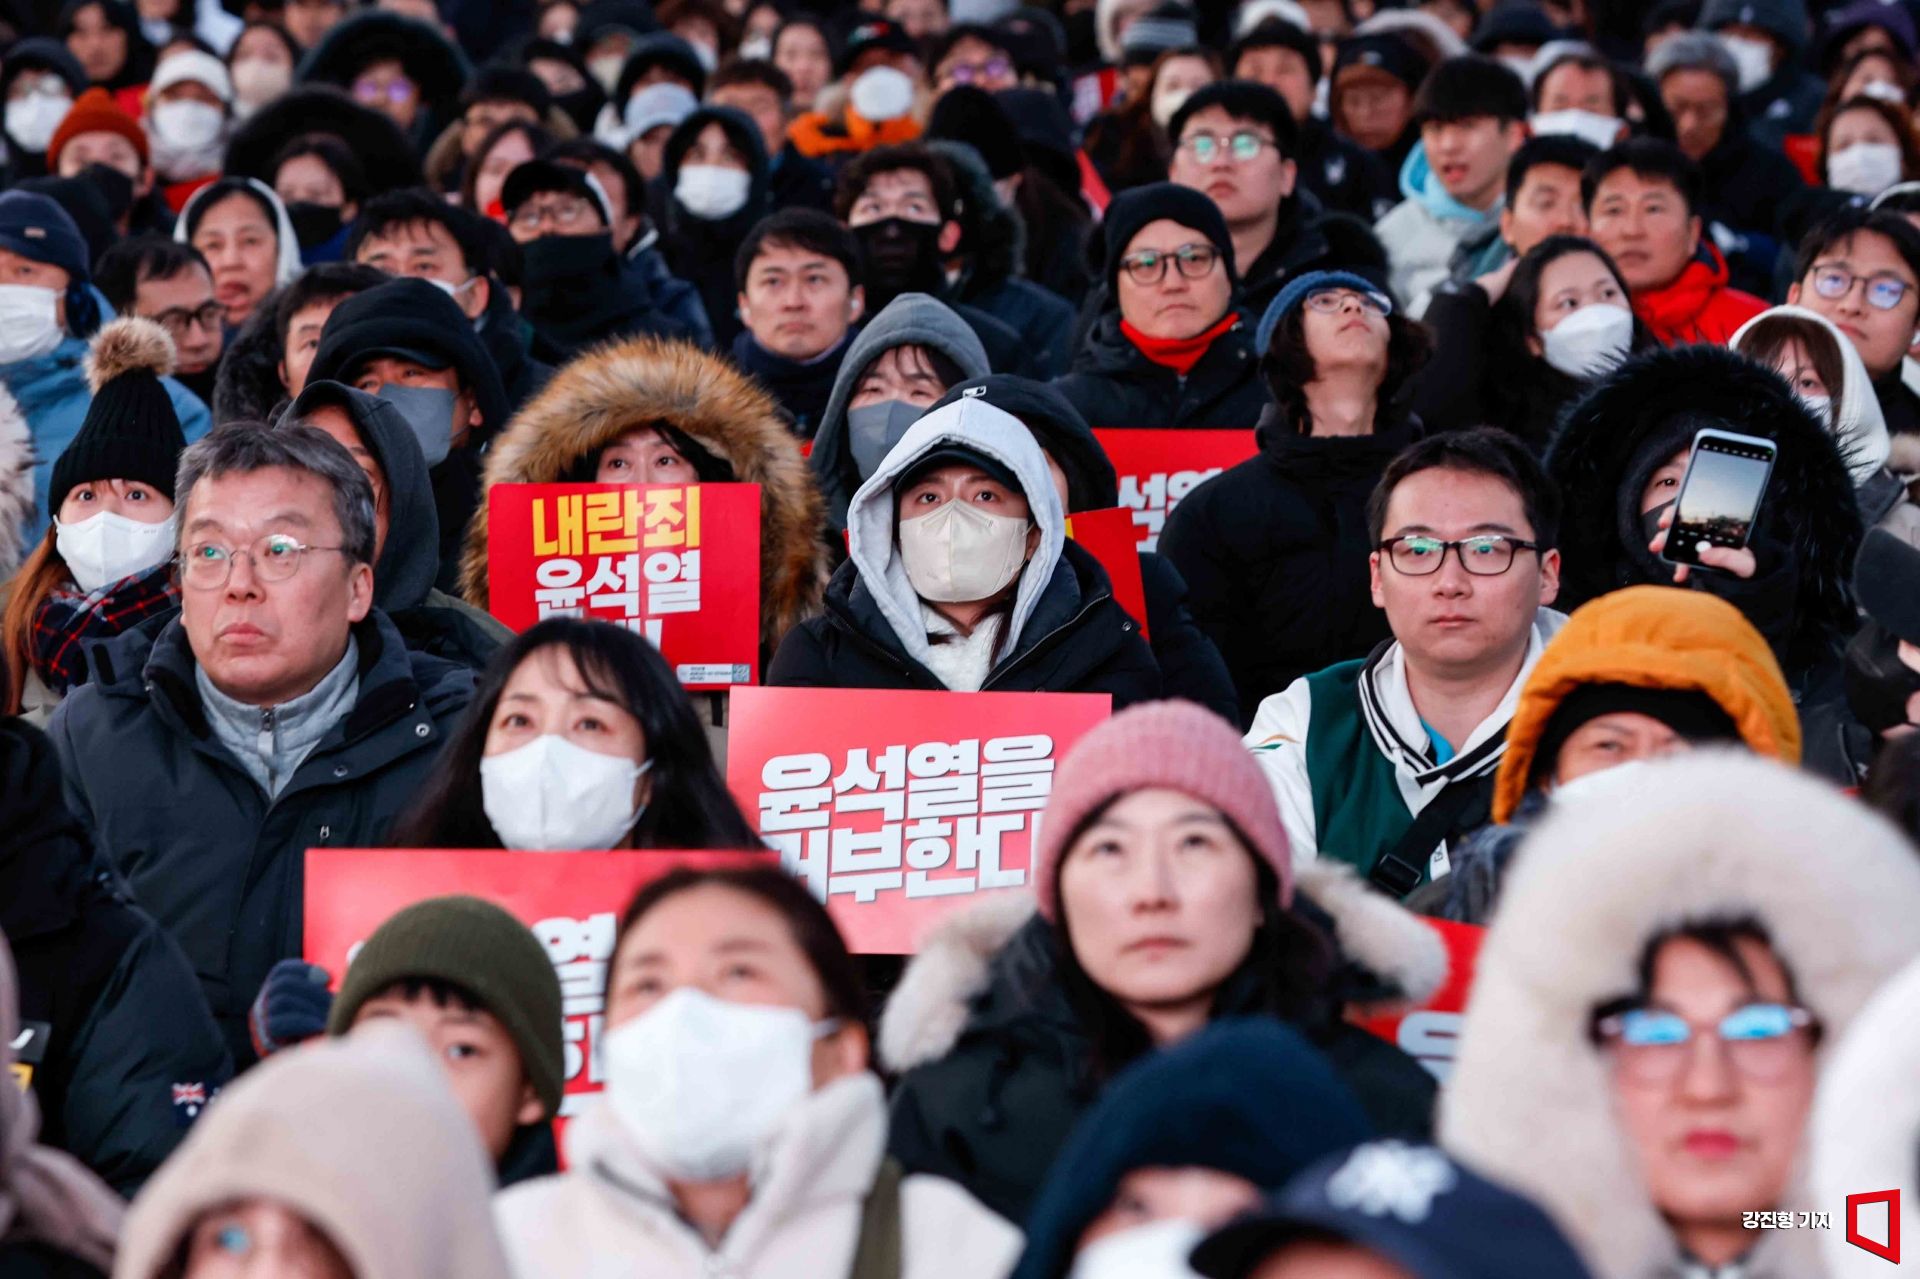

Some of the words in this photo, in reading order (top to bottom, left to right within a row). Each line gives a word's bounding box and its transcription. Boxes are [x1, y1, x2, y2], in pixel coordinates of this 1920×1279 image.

[532, 485, 700, 557] 내란죄
[534, 549, 701, 621] 윤석열
[758, 734, 1055, 832] 윤석열을
